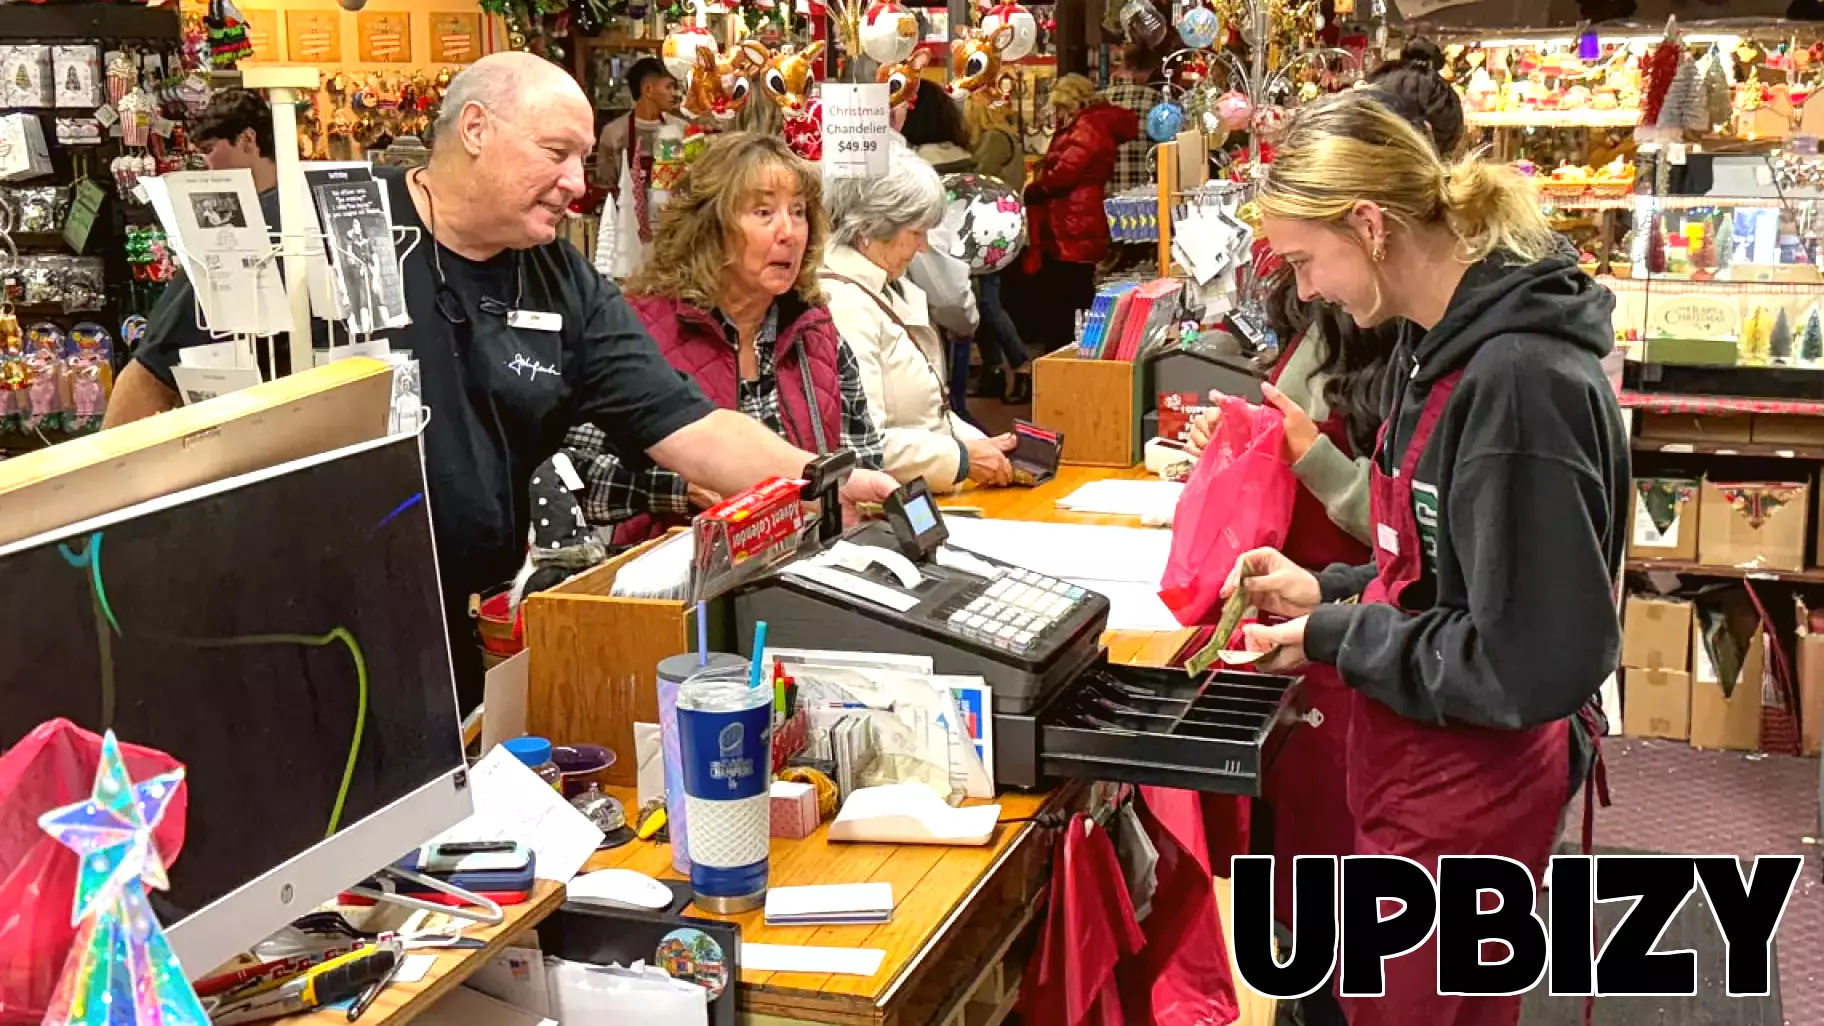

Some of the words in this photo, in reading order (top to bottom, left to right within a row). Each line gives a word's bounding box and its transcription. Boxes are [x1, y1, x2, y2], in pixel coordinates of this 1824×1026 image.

[829, 105, 885, 117] Christmas
[826, 122, 888, 134] Chandelier
[838, 140, 877, 152] $49.99
[771, 499, 800, 528] Advent
[732, 517, 771, 549] Calendar
